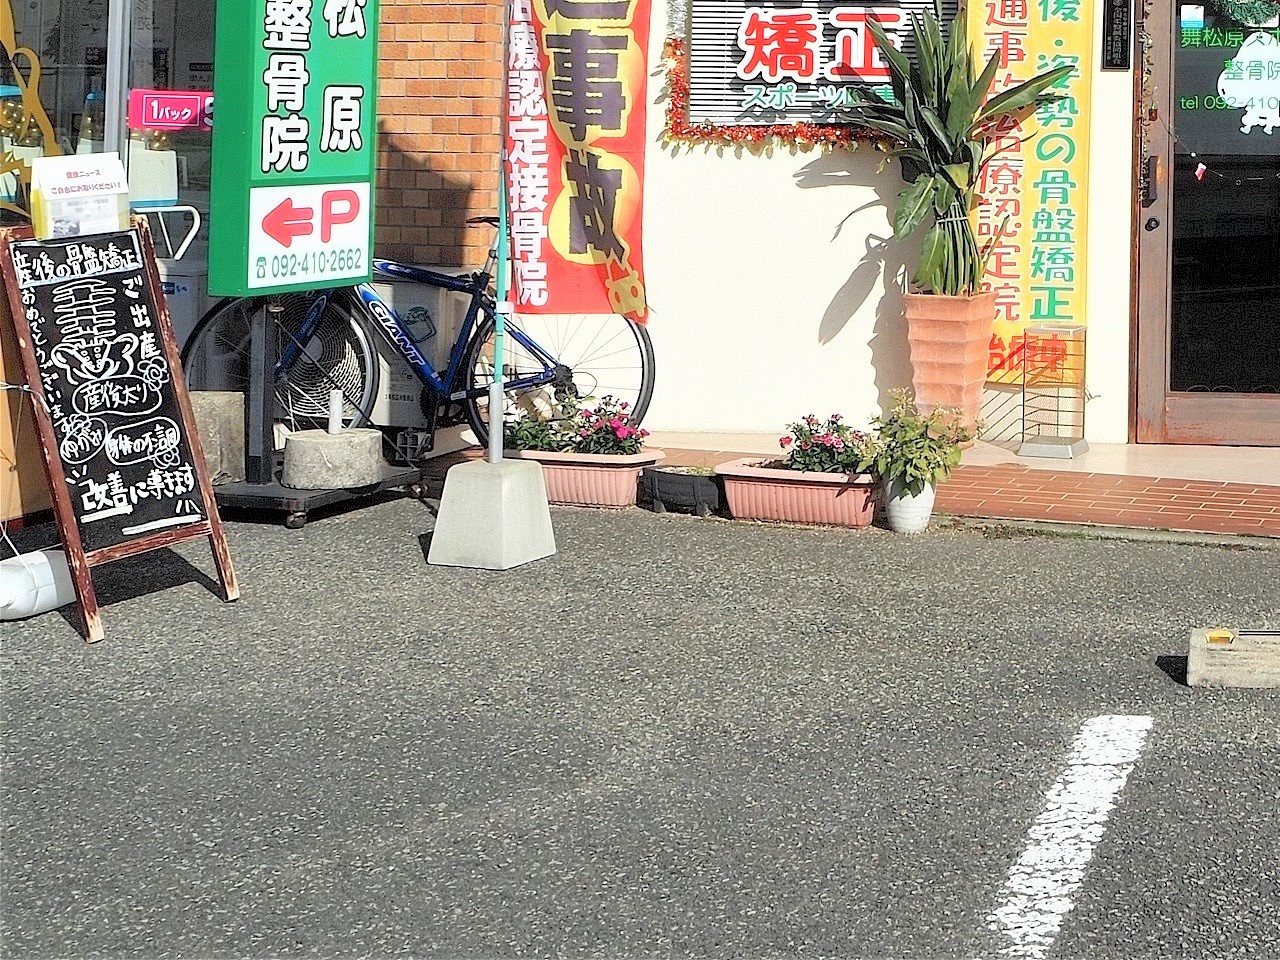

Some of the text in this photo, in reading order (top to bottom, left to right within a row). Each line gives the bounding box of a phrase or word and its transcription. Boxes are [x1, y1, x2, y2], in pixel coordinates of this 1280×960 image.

[743, 12, 901, 78] 矯正
[1180, 95, 1199, 110] tel
[321, 189, 360, 244] P
[368, 300, 426, 366] GIANT
